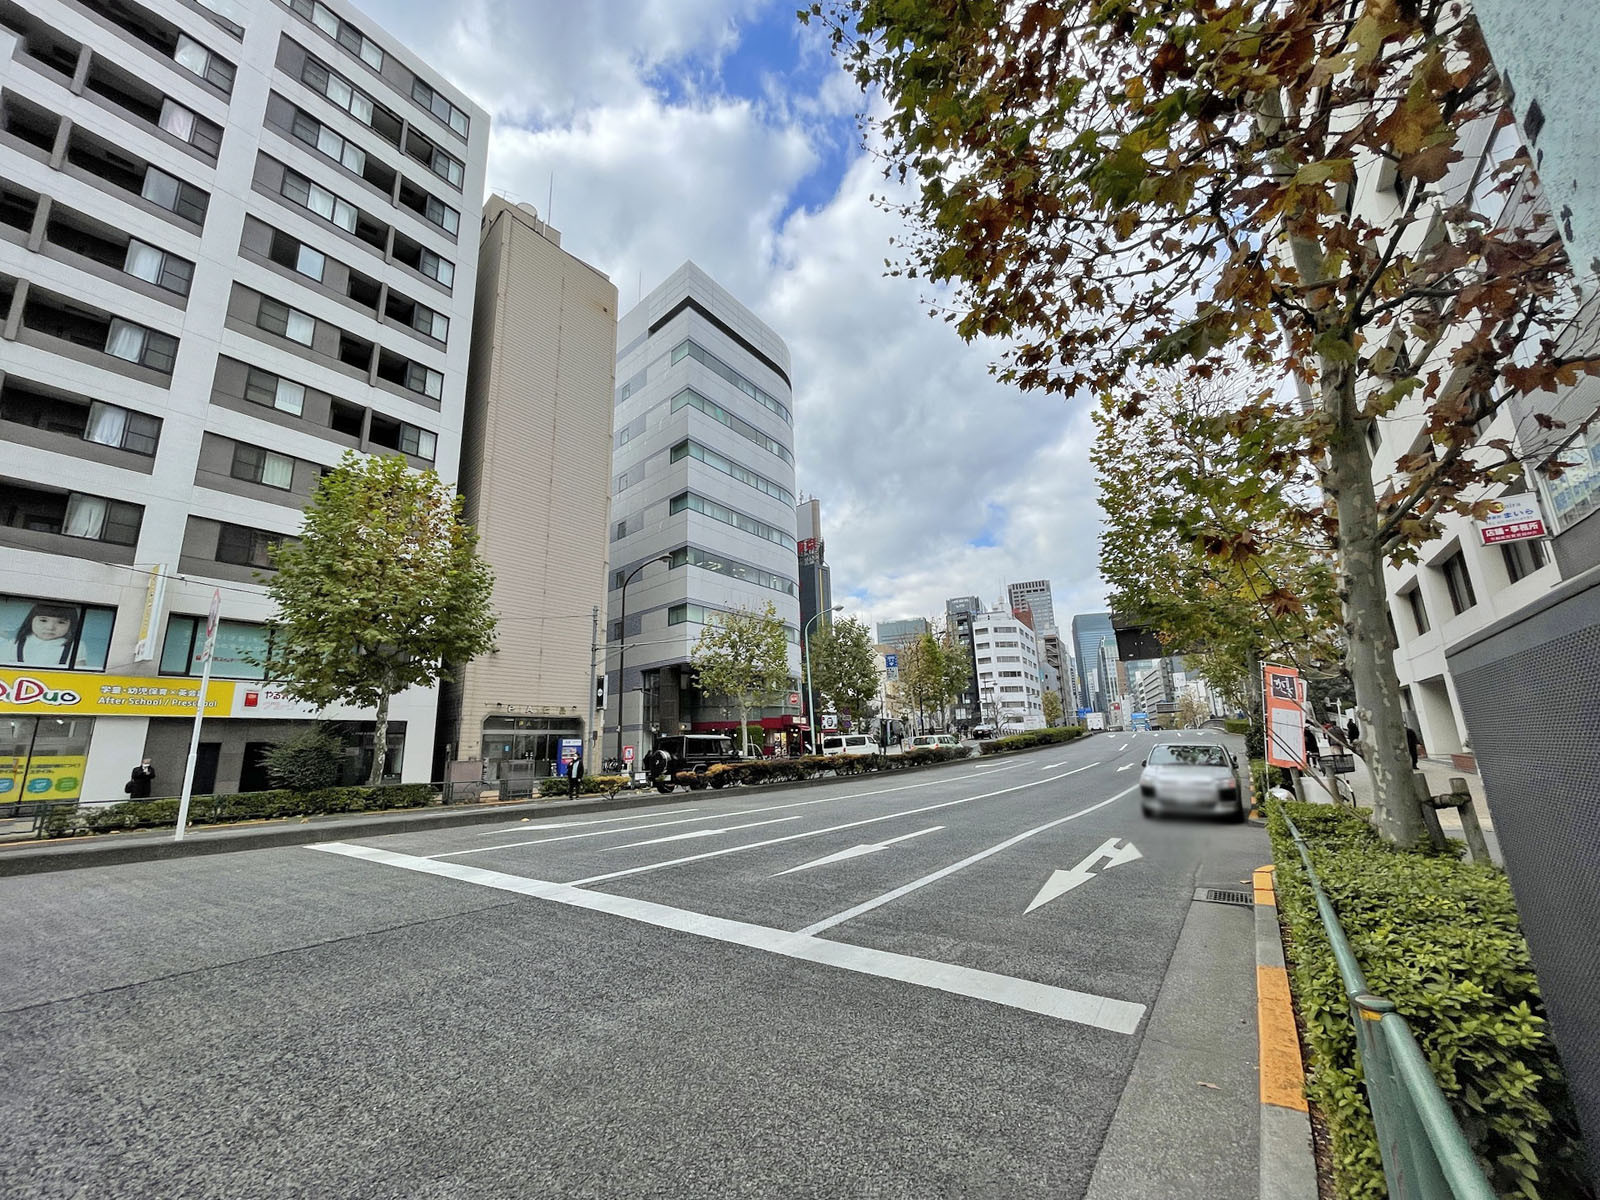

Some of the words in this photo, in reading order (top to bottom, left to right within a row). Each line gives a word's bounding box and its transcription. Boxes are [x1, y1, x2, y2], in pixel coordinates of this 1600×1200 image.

[98, 697, 126, 705] After
[128, 698, 162, 706] School
[172, 699, 217, 707] Prescool
